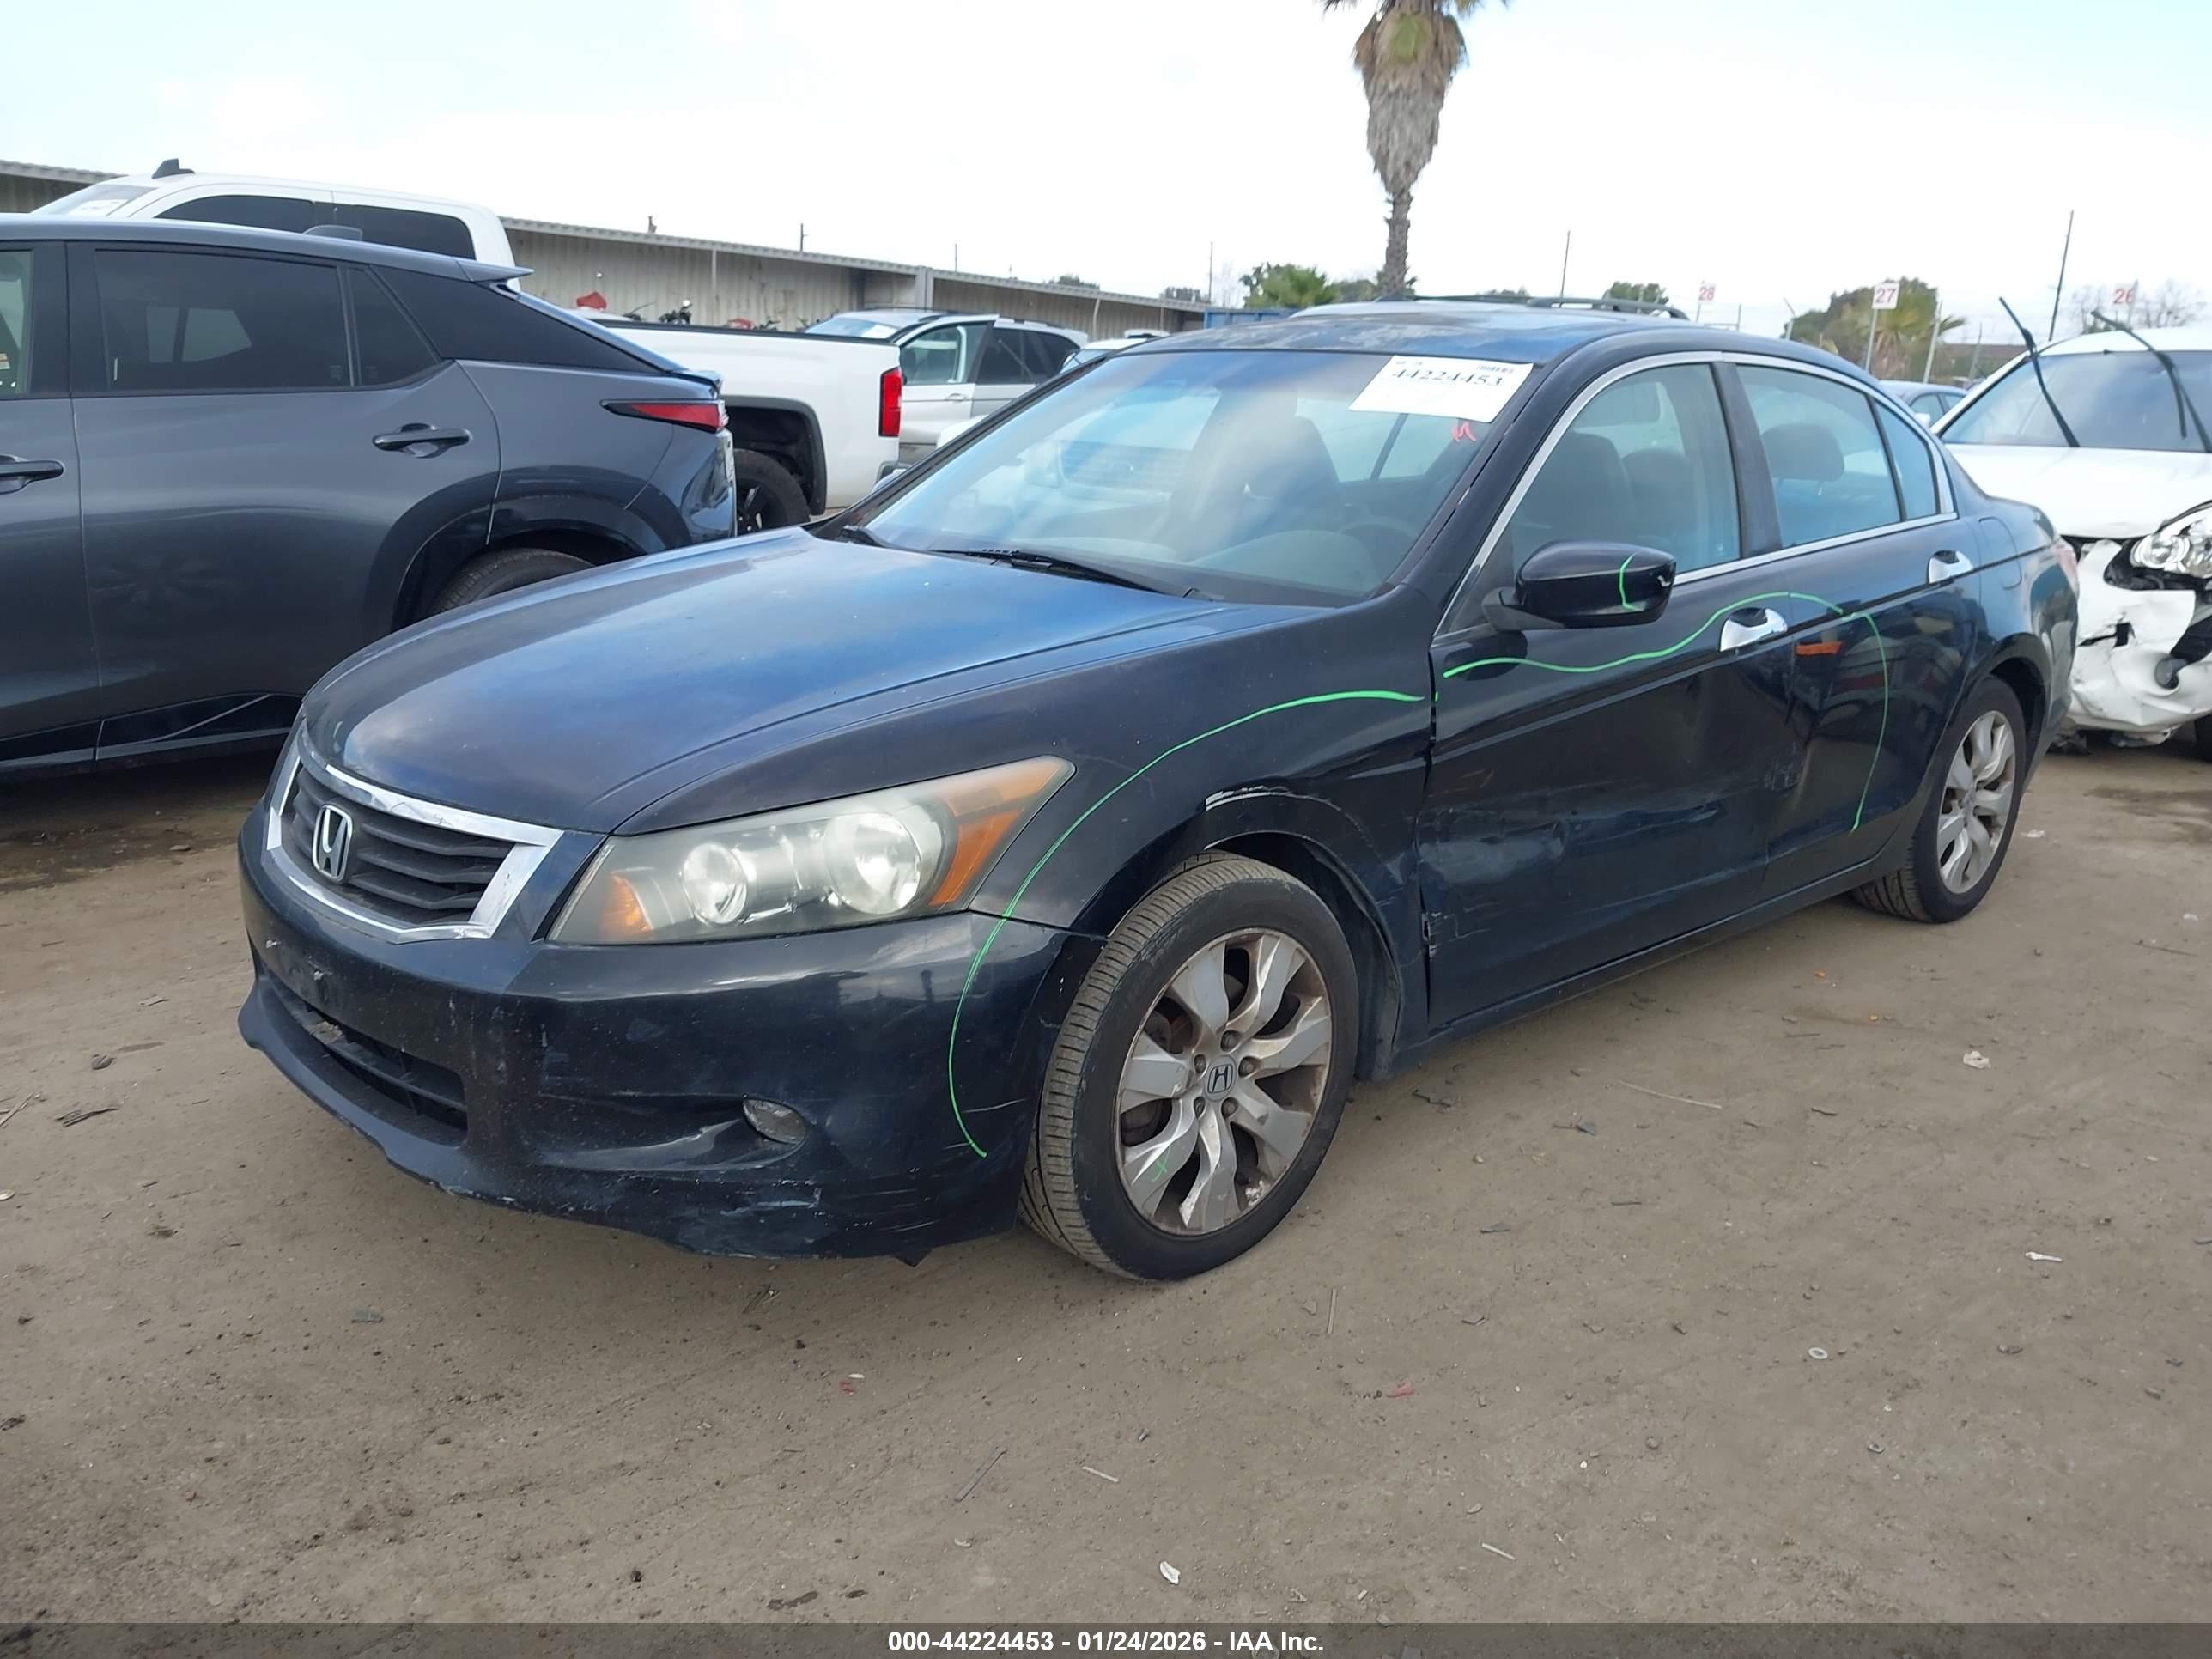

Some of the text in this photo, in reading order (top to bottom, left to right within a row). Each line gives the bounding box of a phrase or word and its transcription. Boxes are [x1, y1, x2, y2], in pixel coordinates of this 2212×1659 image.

[1698, 286, 1716, 301] 28
[1875, 288, 1897, 303] 27
[1391, 368, 1504, 386] 44224453
